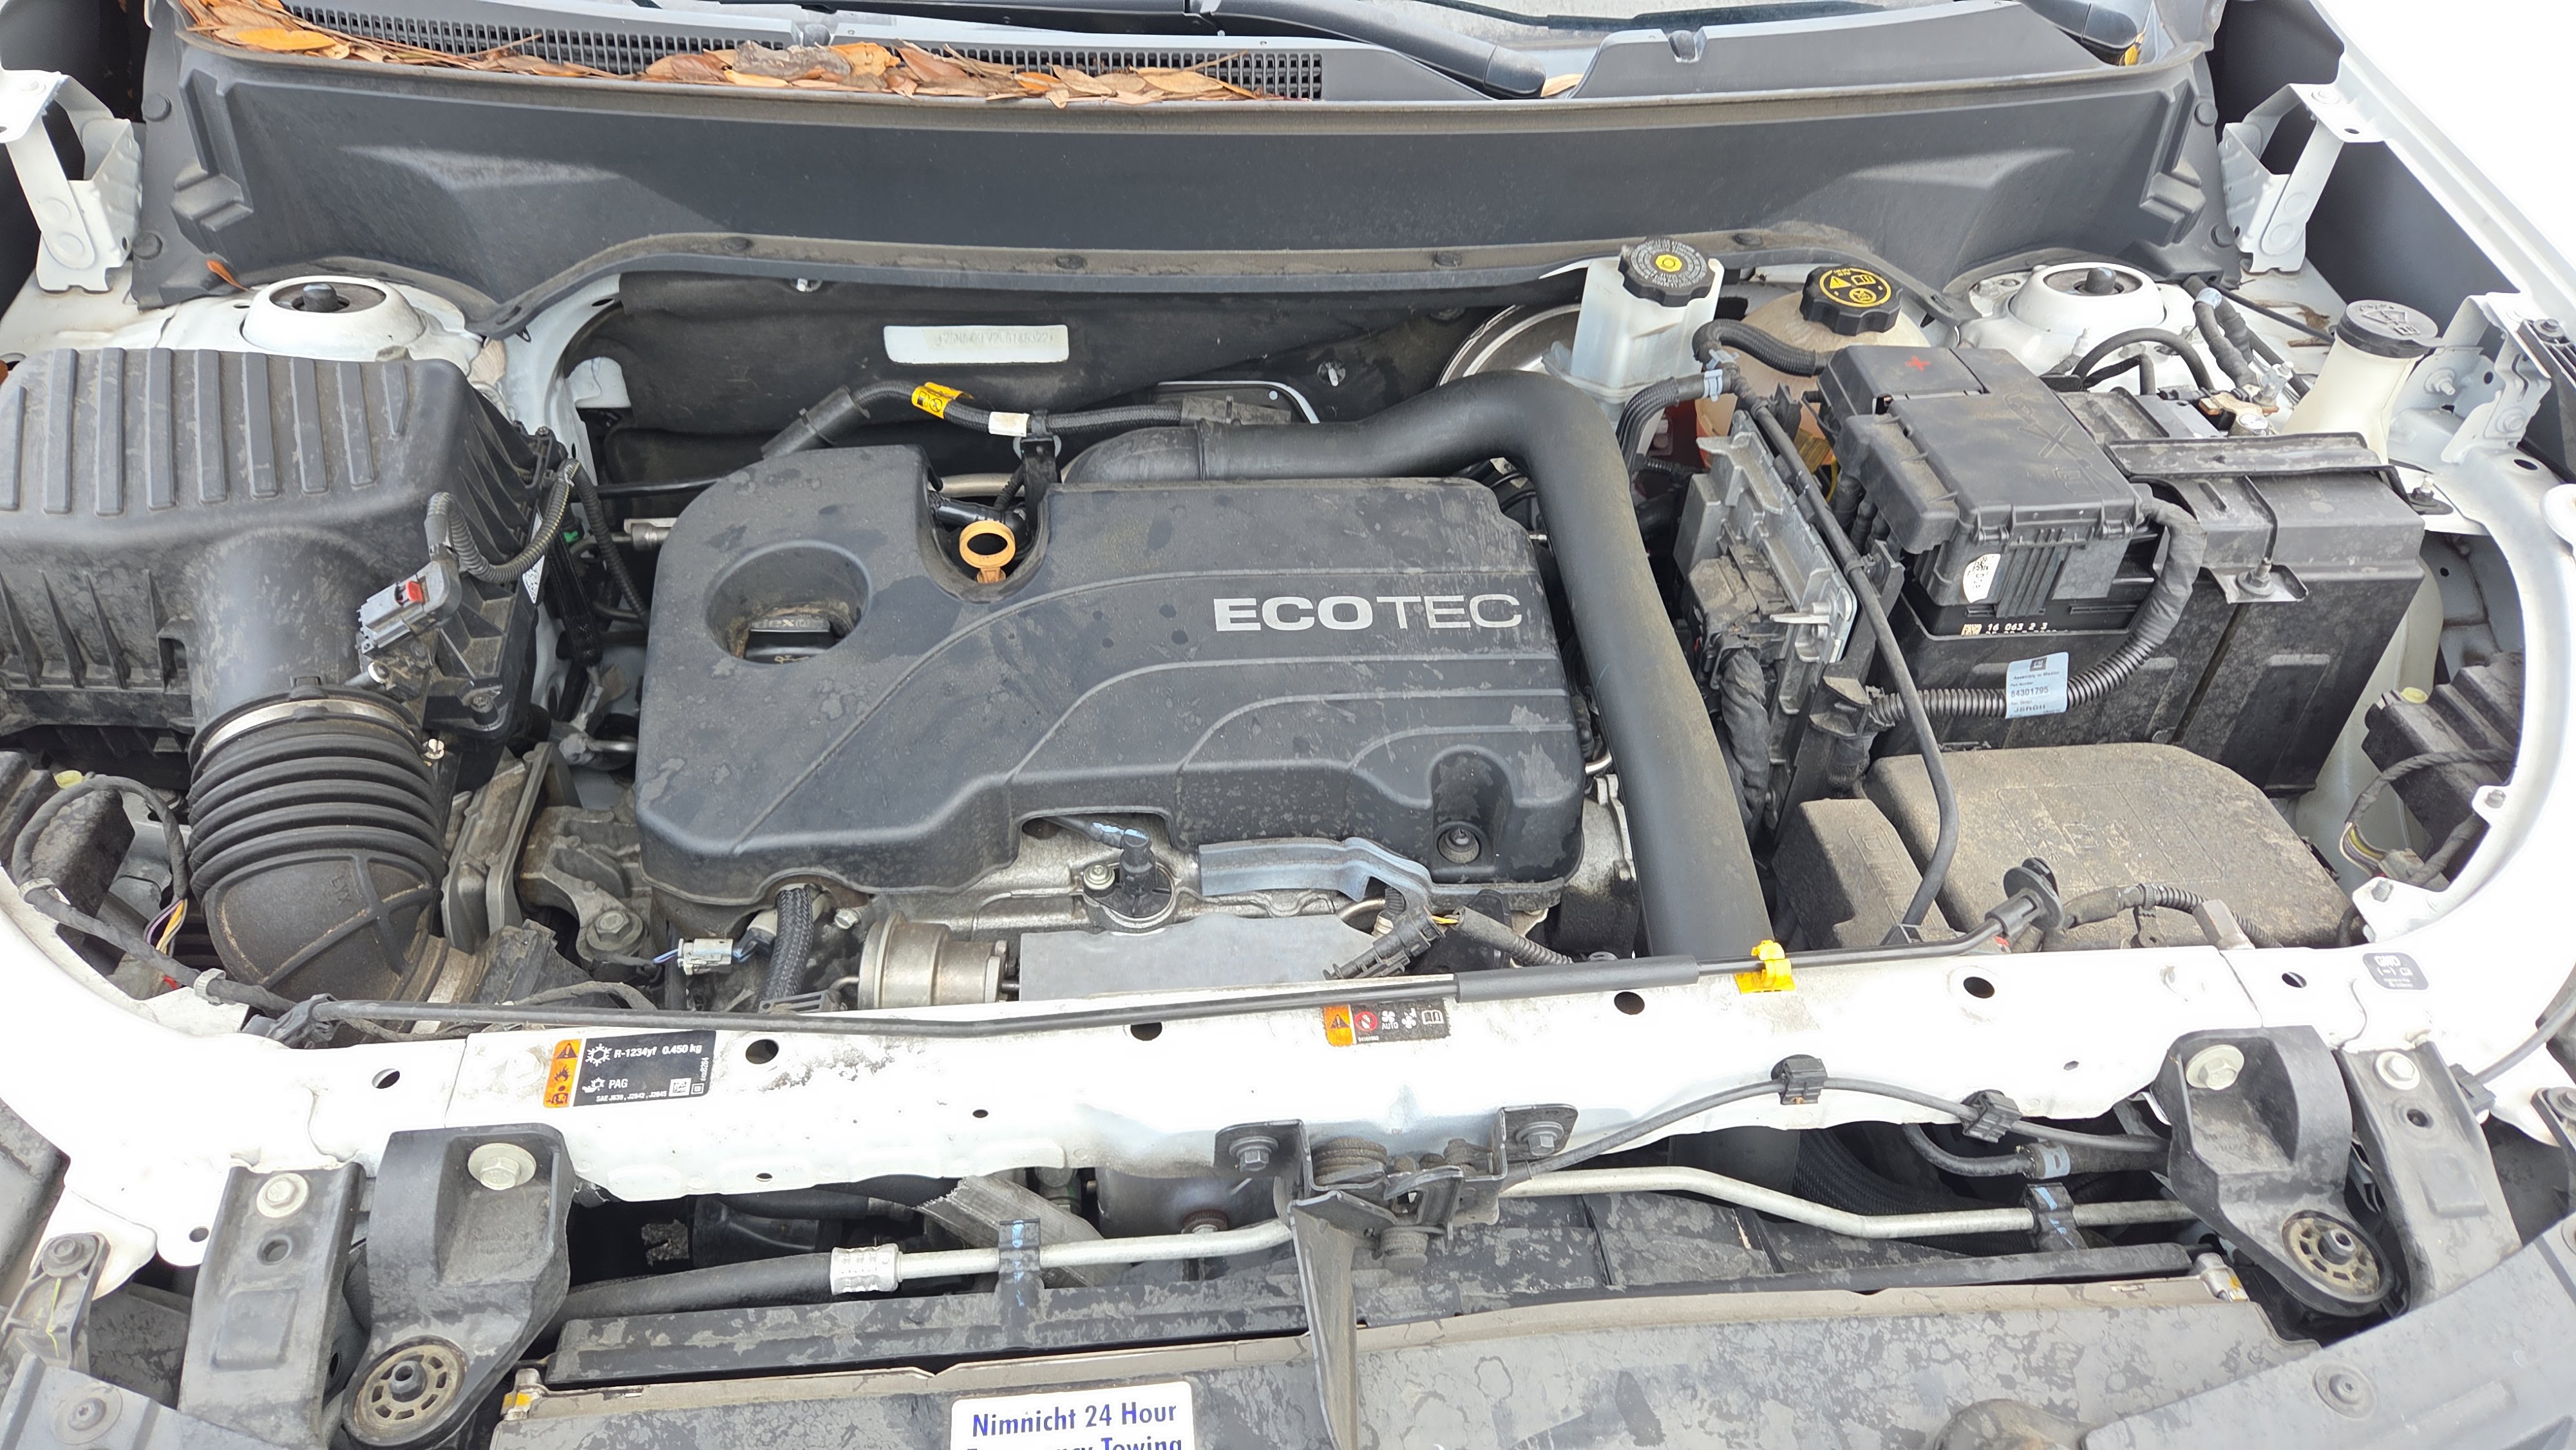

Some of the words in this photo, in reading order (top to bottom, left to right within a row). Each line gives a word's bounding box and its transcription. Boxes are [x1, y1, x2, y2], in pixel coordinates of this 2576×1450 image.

[1213, 594, 1522, 632] ECOTEC
[2004, 623, 2024, 631] 063
[2028, 622, 2036, 630] 2
[2011, 686, 2049, 698] 84301795
[1381, 1021, 1399, 1030] AUTO
[614, 1046, 657, 1058] R-1234yf
[662, 1044, 688, 1055] 0.450
[690, 1044, 703, 1053] kg
[609, 1078, 629, 1089] PAG
[972, 1406, 1076, 1437] Nimnicht
[1085, 1404, 1112, 1427] 24
[1121, 1402, 1177, 1425] Hour
